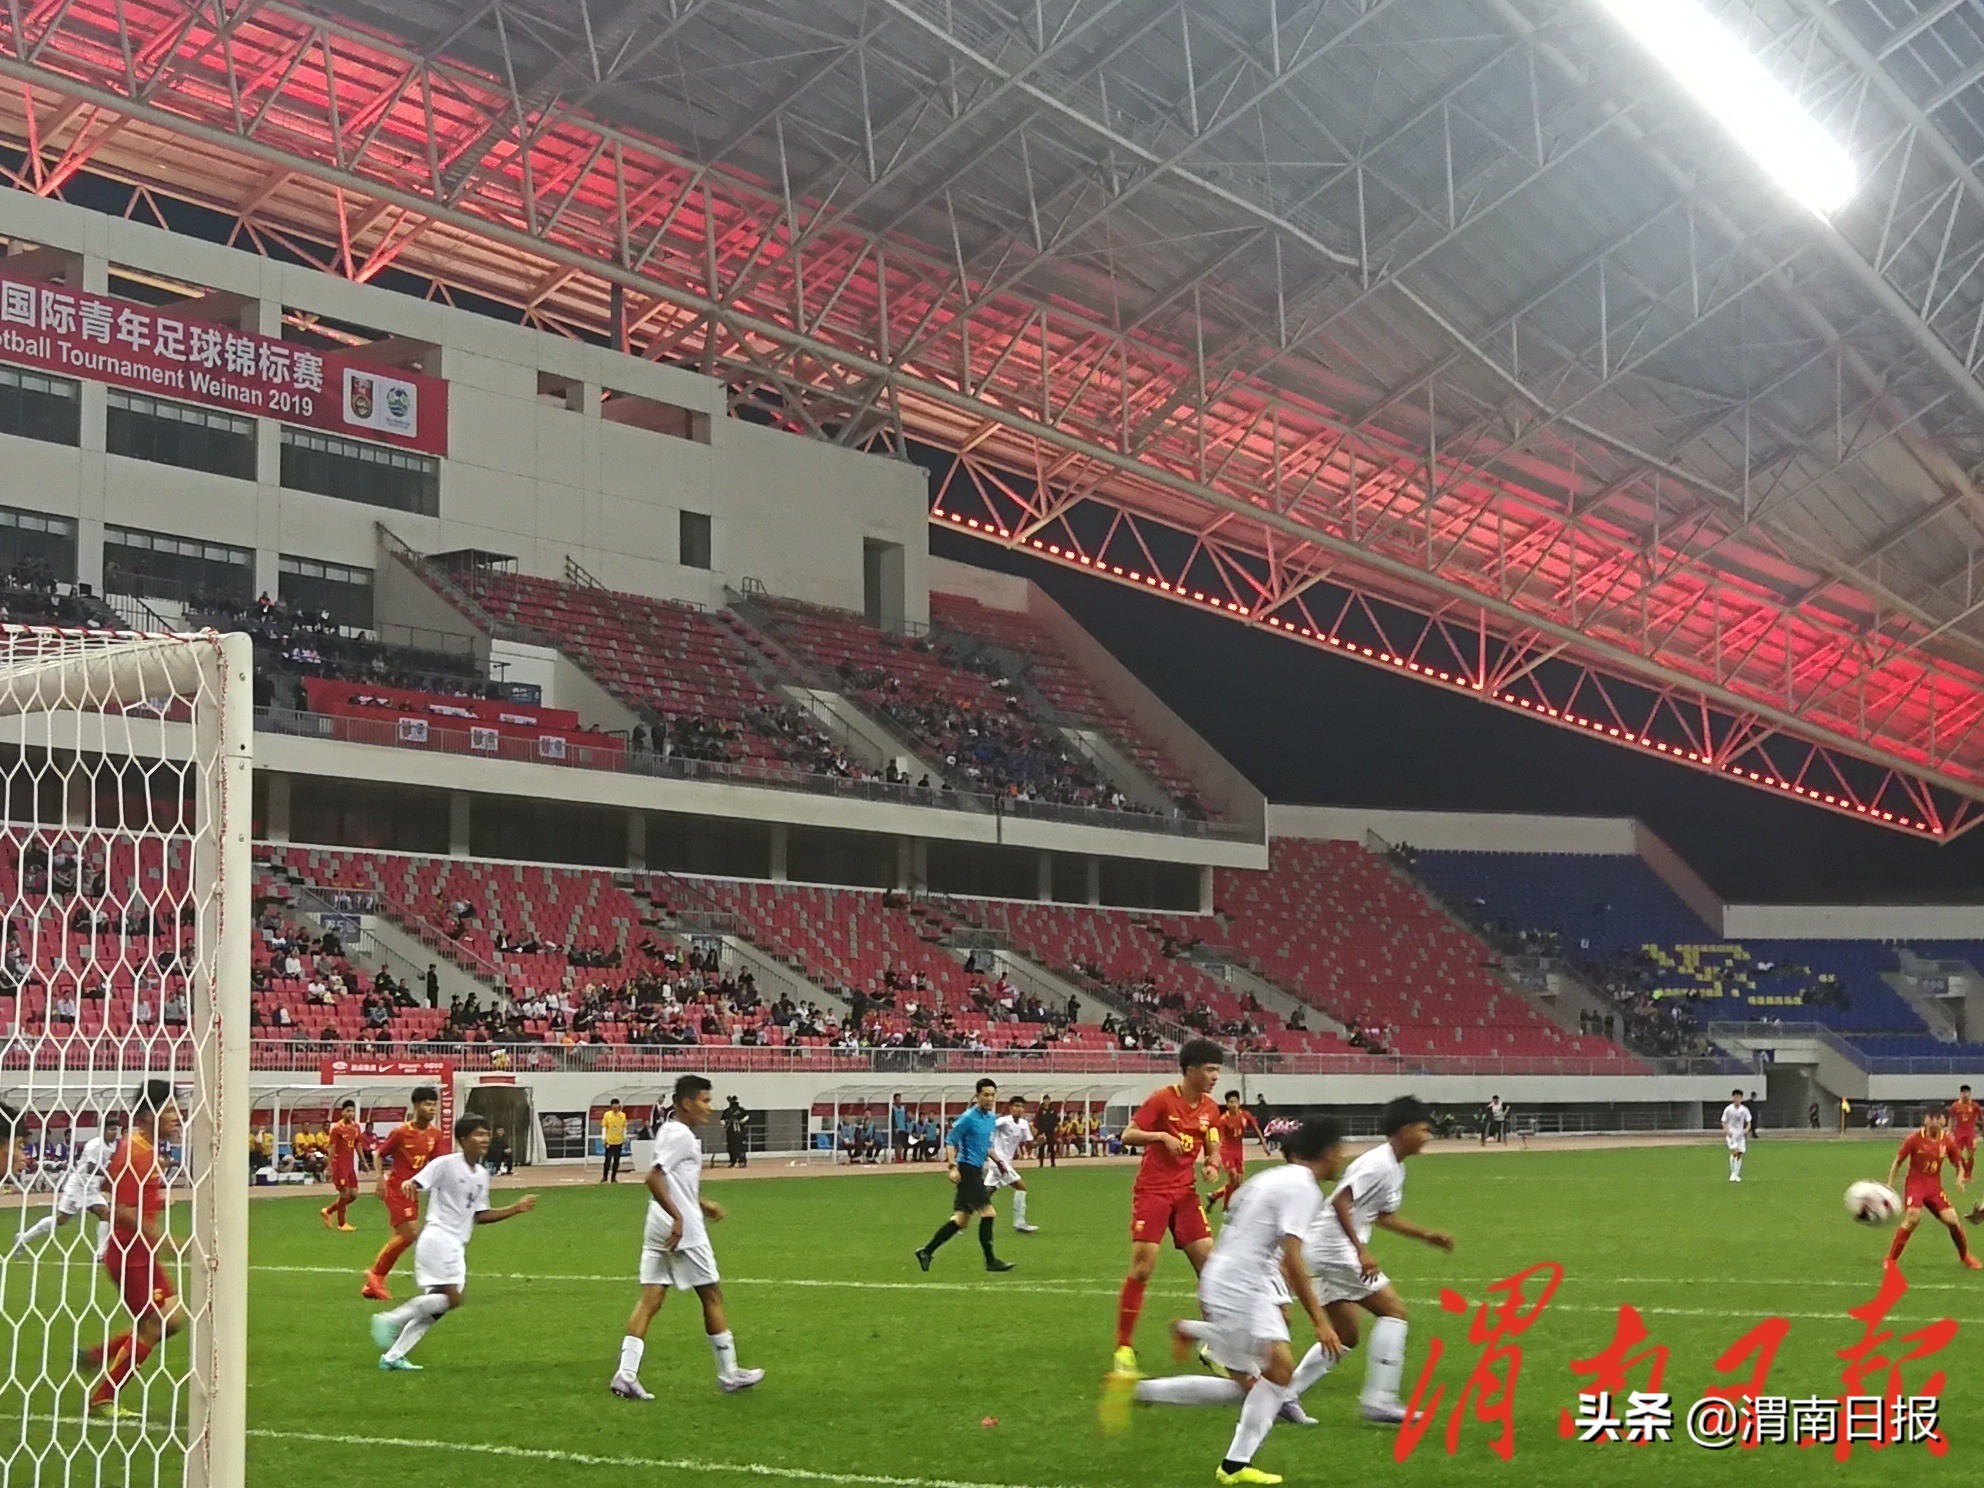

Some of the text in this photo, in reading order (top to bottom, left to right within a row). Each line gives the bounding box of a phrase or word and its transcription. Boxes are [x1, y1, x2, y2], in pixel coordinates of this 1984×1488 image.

[0, 329, 313, 416] tball Tournament Weinan 2019
[1, 280, 323, 393] 国际青年足球锦标赛
